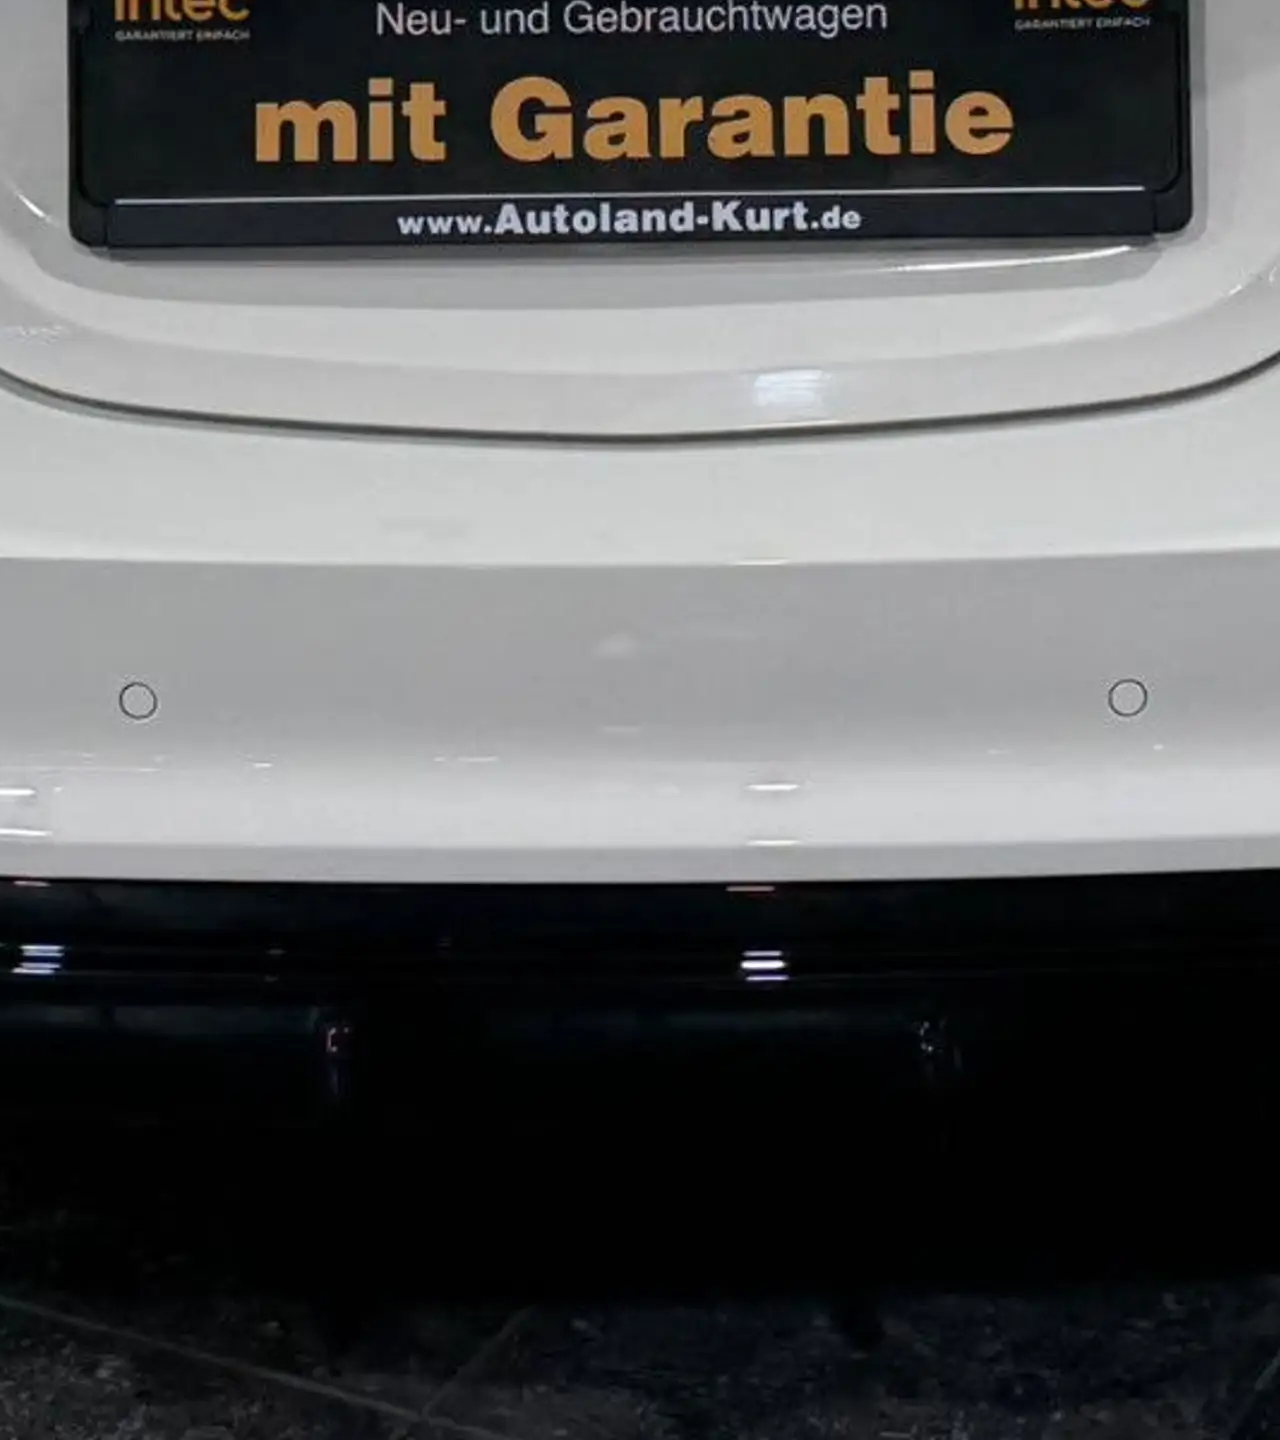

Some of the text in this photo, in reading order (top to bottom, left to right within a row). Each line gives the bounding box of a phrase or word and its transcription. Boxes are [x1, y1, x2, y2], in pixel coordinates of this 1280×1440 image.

[376, 0, 888, 38] Neu- und Gebrauchtwagen
[254, 71, 1015, 163] mit Garantie
[397, 200, 862, 236] www.Autoland-Kurt.de
